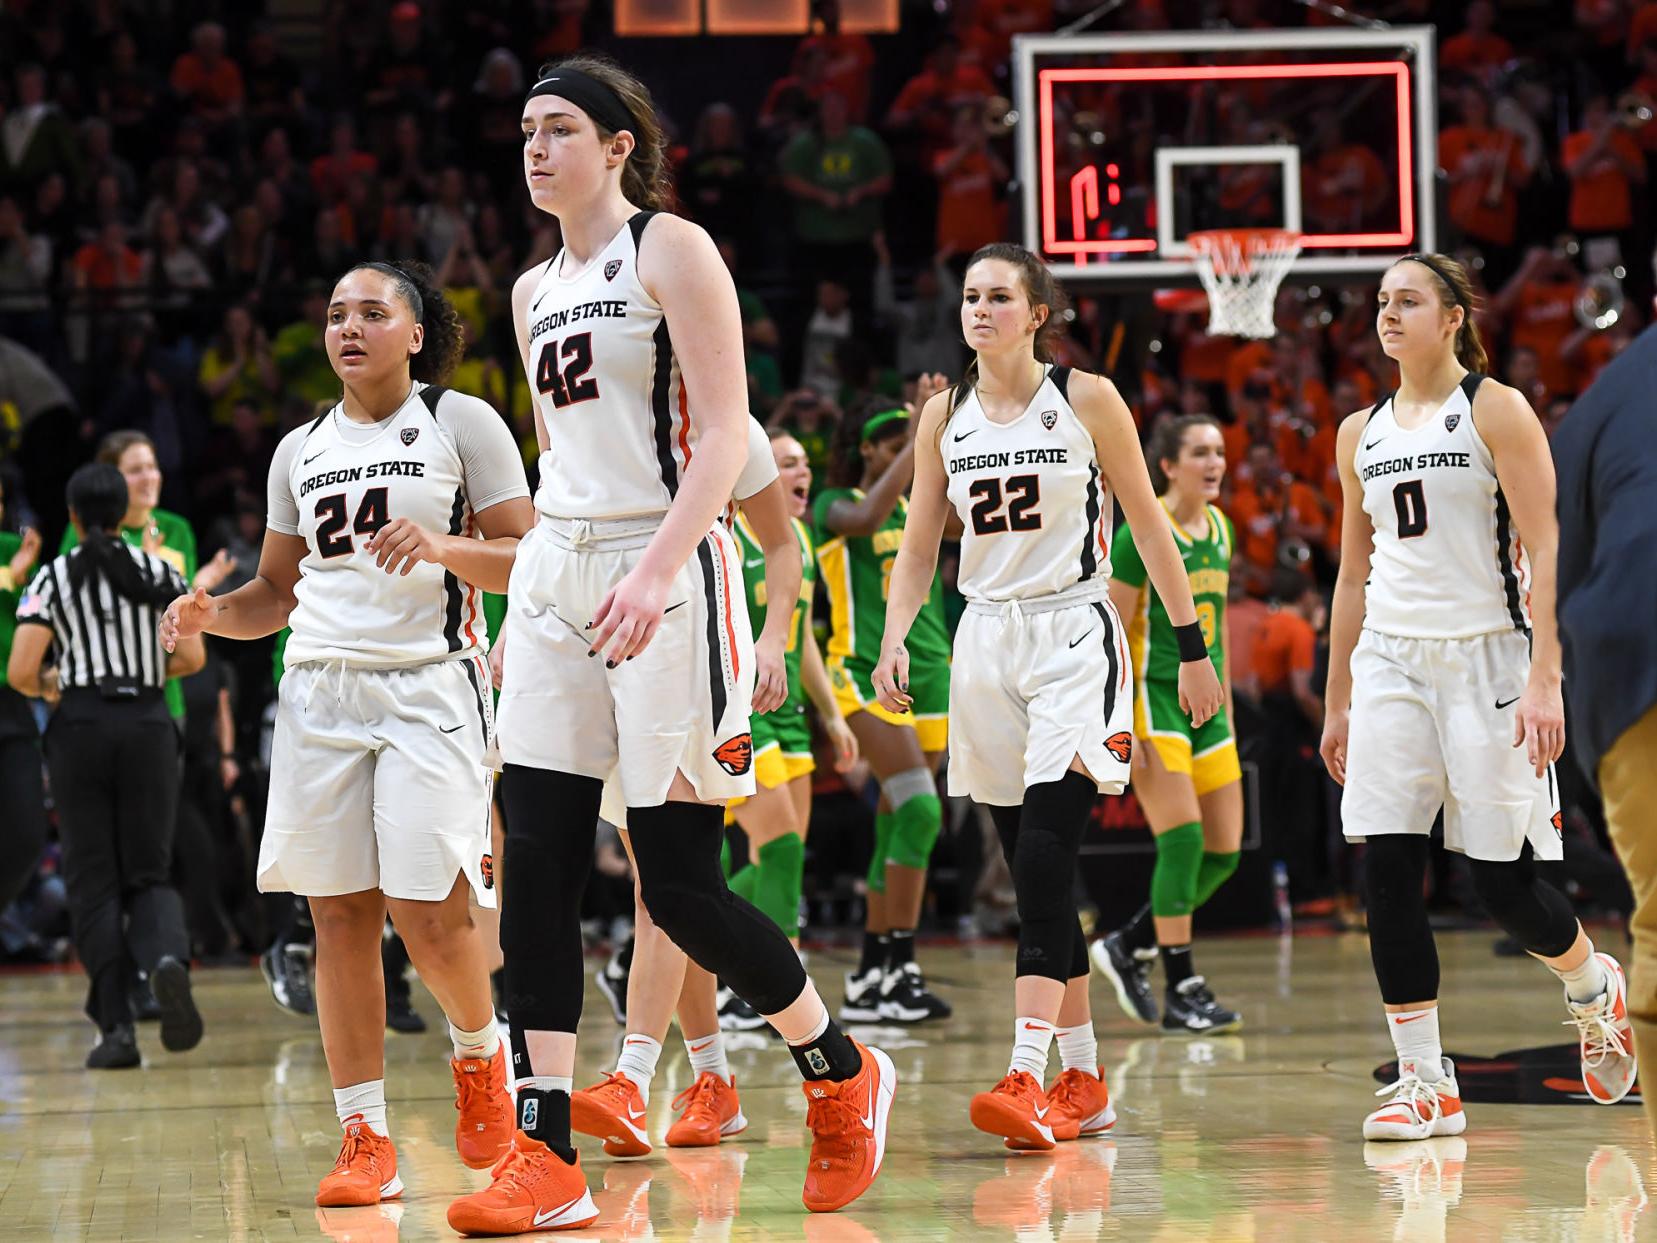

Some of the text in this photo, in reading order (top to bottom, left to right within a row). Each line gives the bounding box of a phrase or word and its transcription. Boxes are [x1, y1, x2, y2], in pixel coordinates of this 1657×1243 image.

[571, 300, 628, 323] STATE
[536, 331, 600, 409] 42
[300, 460, 425, 498] OREGON STATE
[950, 448, 1068, 474] OREGON STATE
[1363, 452, 1470, 482] OREGON STATE
[314, 486, 392, 559] 24
[969, 473, 1042, 536] 22
[1392, 479, 1428, 540] 0
